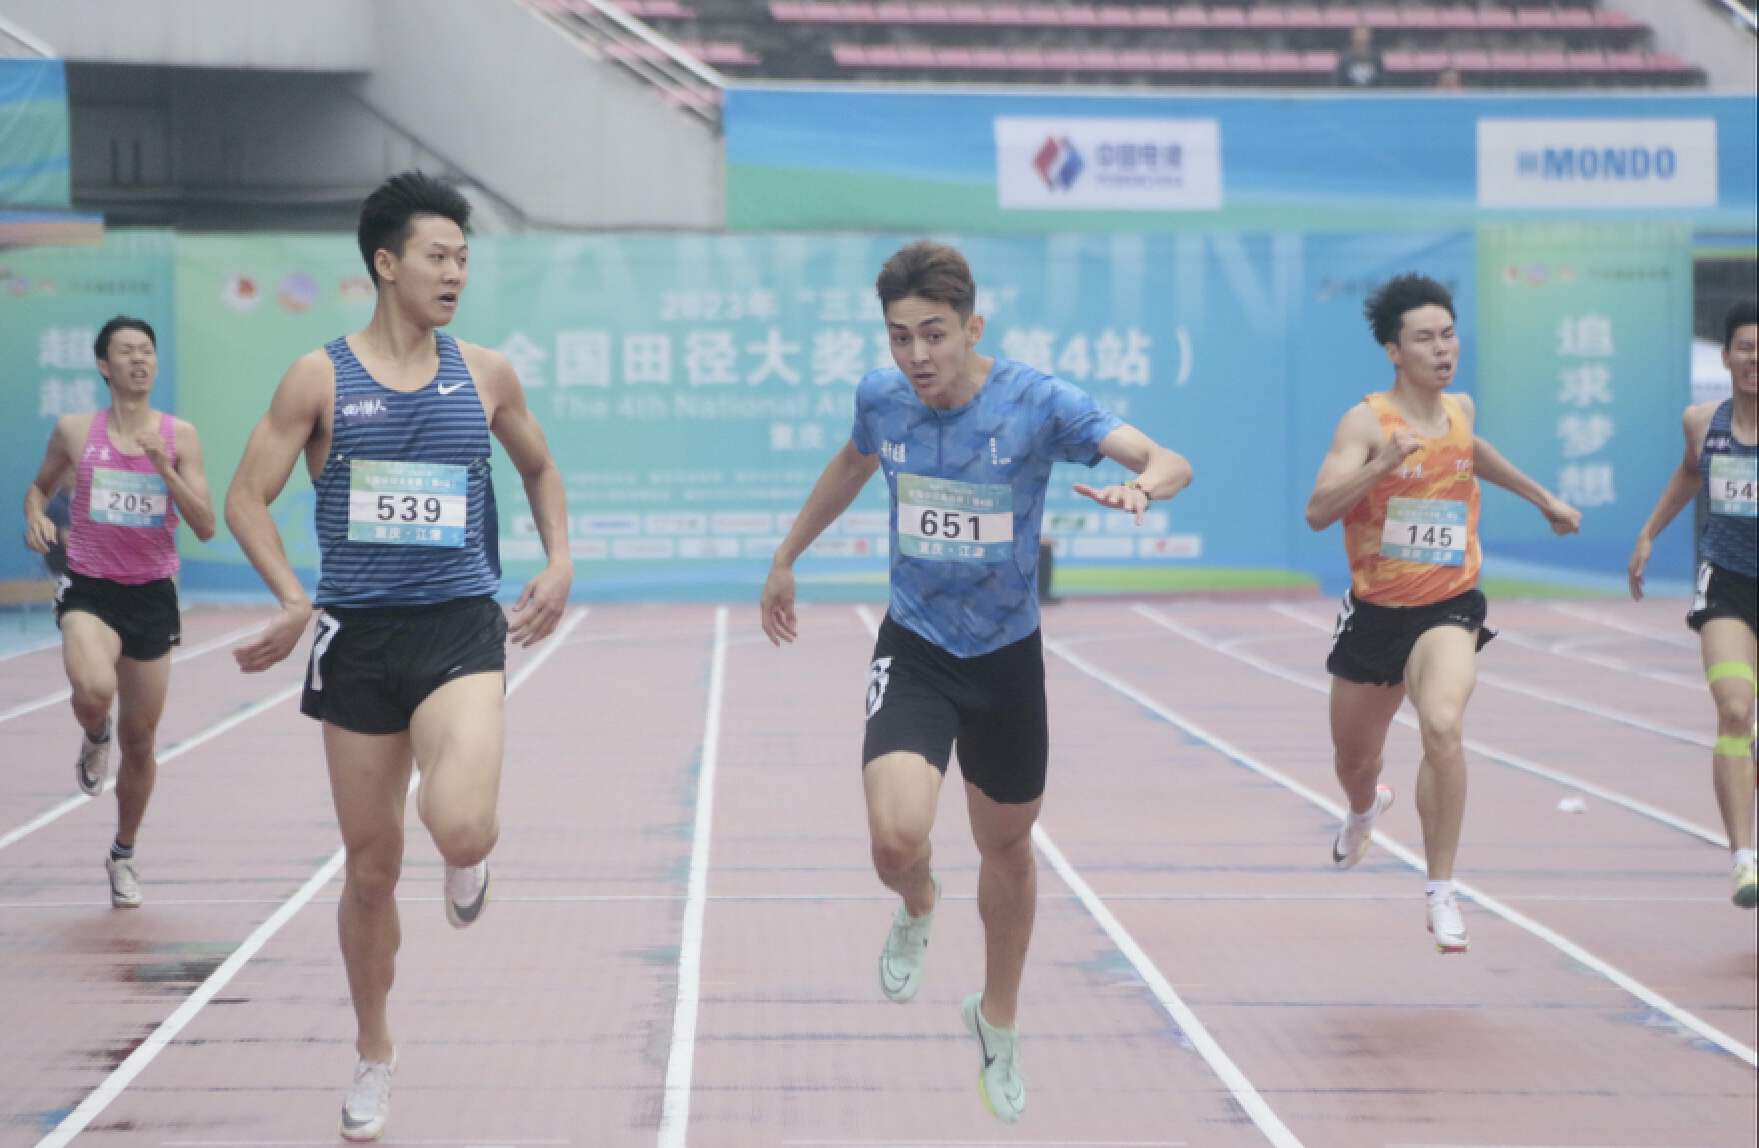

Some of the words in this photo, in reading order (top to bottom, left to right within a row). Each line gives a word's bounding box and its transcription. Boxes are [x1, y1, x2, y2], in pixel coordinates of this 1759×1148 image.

[1544, 146, 1677, 181] MONDO
[1556, 314, 1615, 507] 追求梦想
[109, 492, 152, 512] 205
[377, 495, 441, 522] 539
[920, 509, 980, 541] 651
[1408, 525, 1452, 547] 145
[311, 611, 341, 690] 7
